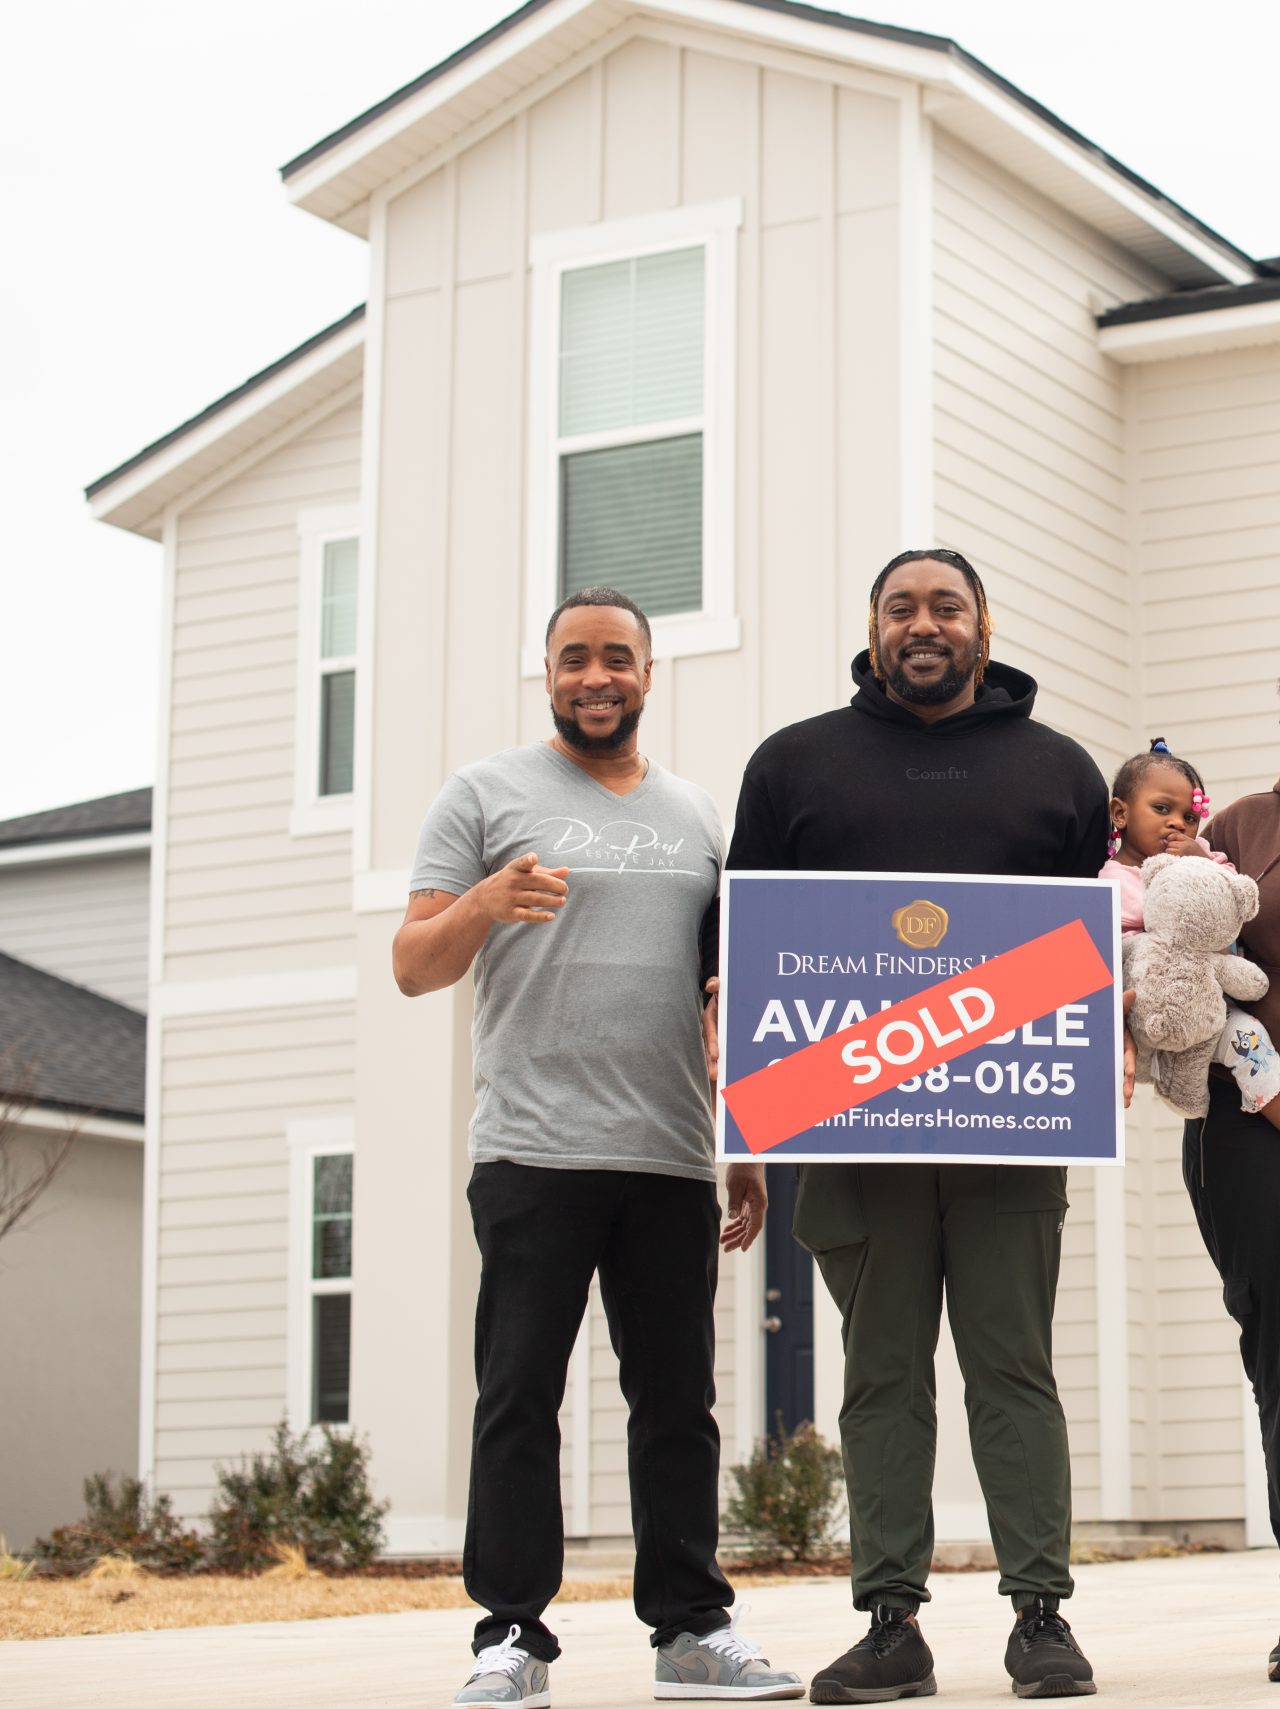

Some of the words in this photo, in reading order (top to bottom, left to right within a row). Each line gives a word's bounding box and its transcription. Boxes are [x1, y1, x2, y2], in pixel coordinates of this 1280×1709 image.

[905, 766, 968, 780] Comfrt
[585, 848, 639, 864] ESTATE
[649, 857, 675, 867] JAX
[906, 916, 937, 934] DF
[841, 987, 995, 1084] SOLD
[814, 1107, 1072, 1131] mFindersHomes.com
